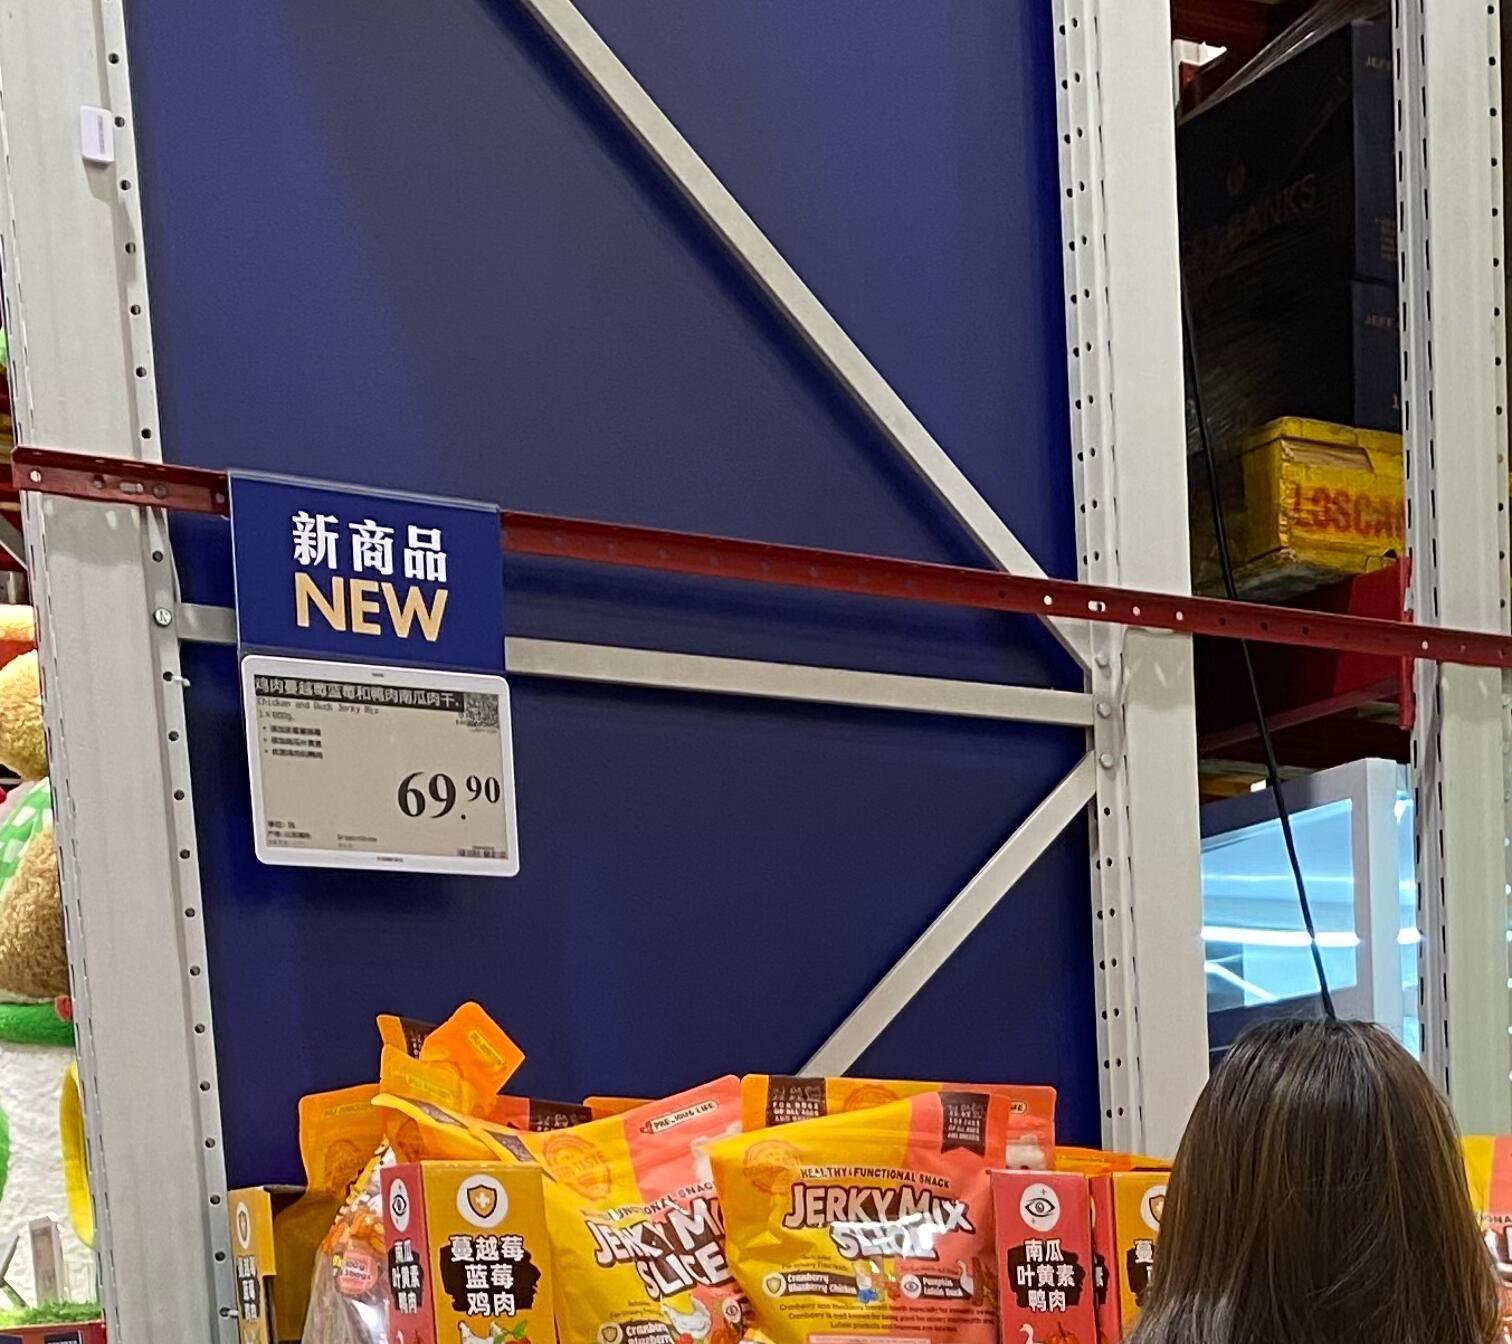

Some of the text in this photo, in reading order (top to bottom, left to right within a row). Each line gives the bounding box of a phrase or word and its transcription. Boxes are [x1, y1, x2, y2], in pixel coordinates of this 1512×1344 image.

[292, 510, 447, 583] 新商品
[294, 572, 449, 642] NEW
[397, 771, 501, 819] 69.90
[919, 1173, 951, 1189] SNACK
[783, 1183, 977, 1235] JERKY MIX
[447, 1233, 525, 1264] 蔓越莓
[1025, 1239, 1063, 1263] 南瓜
[464, 1263, 515, 1290] 蓝莓
[637, 1241, 732, 1300] SLICE
[1016, 1263, 1076, 1290] 叶黄素
[466, 1290, 518, 1318] 鸡肉
[1028, 1289, 1067, 1313] 鸭肉
